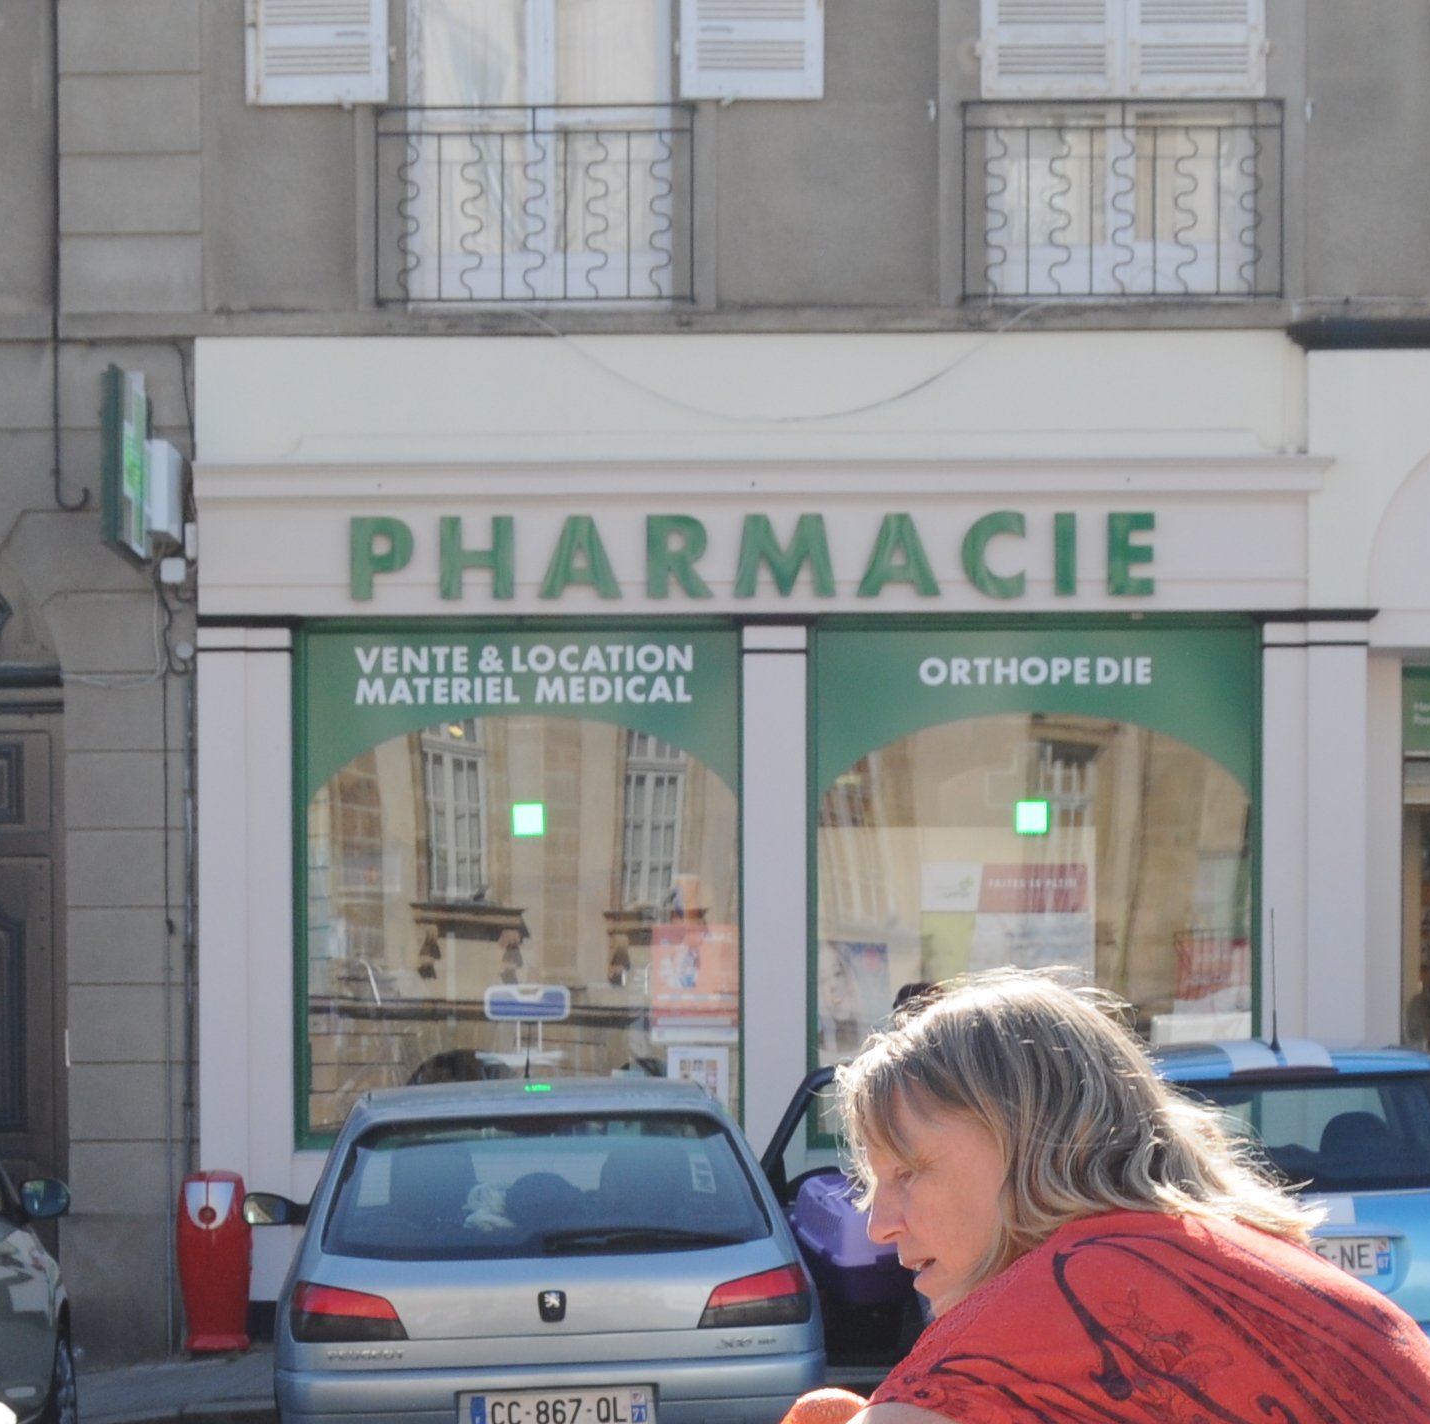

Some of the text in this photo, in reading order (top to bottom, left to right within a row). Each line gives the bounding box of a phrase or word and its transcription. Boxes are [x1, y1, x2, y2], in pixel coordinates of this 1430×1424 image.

[350, 511, 1155, 601] PHARMACIE
[355, 644, 693, 673] VENTE & LOCATION
[355, 675, 692, 704] MATERIEL MEDICAL
